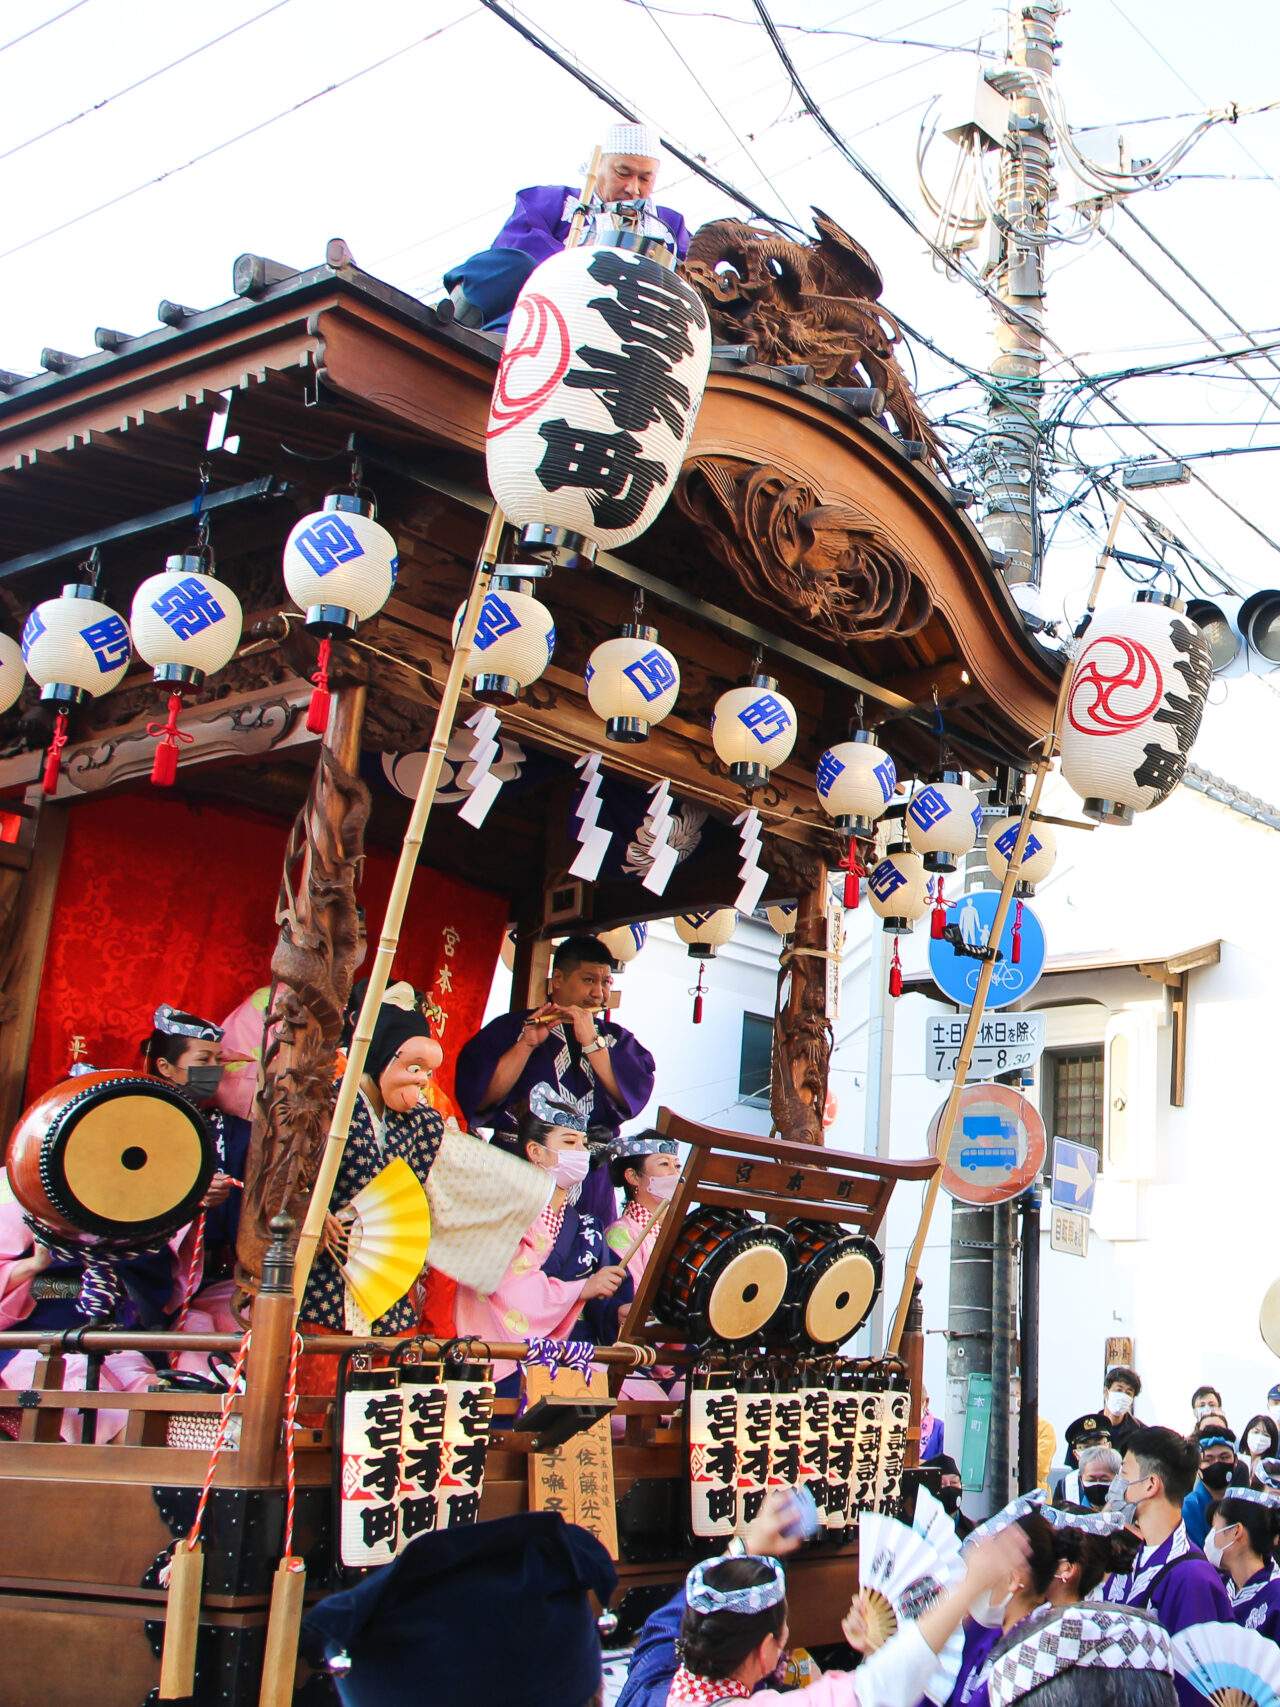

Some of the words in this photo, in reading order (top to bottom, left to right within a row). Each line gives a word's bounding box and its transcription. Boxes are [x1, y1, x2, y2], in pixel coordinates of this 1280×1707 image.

[535, 251, 707, 530] 宮本町
[735, 1161, 855, 1200] 宮本町
[360, 1395, 403, 1554] 宮本町
[401, 1388, 447, 1540] 宮本町
[706, 1395, 738, 1527] 宮本町
[828, 1397, 859, 1516] 宮本町
